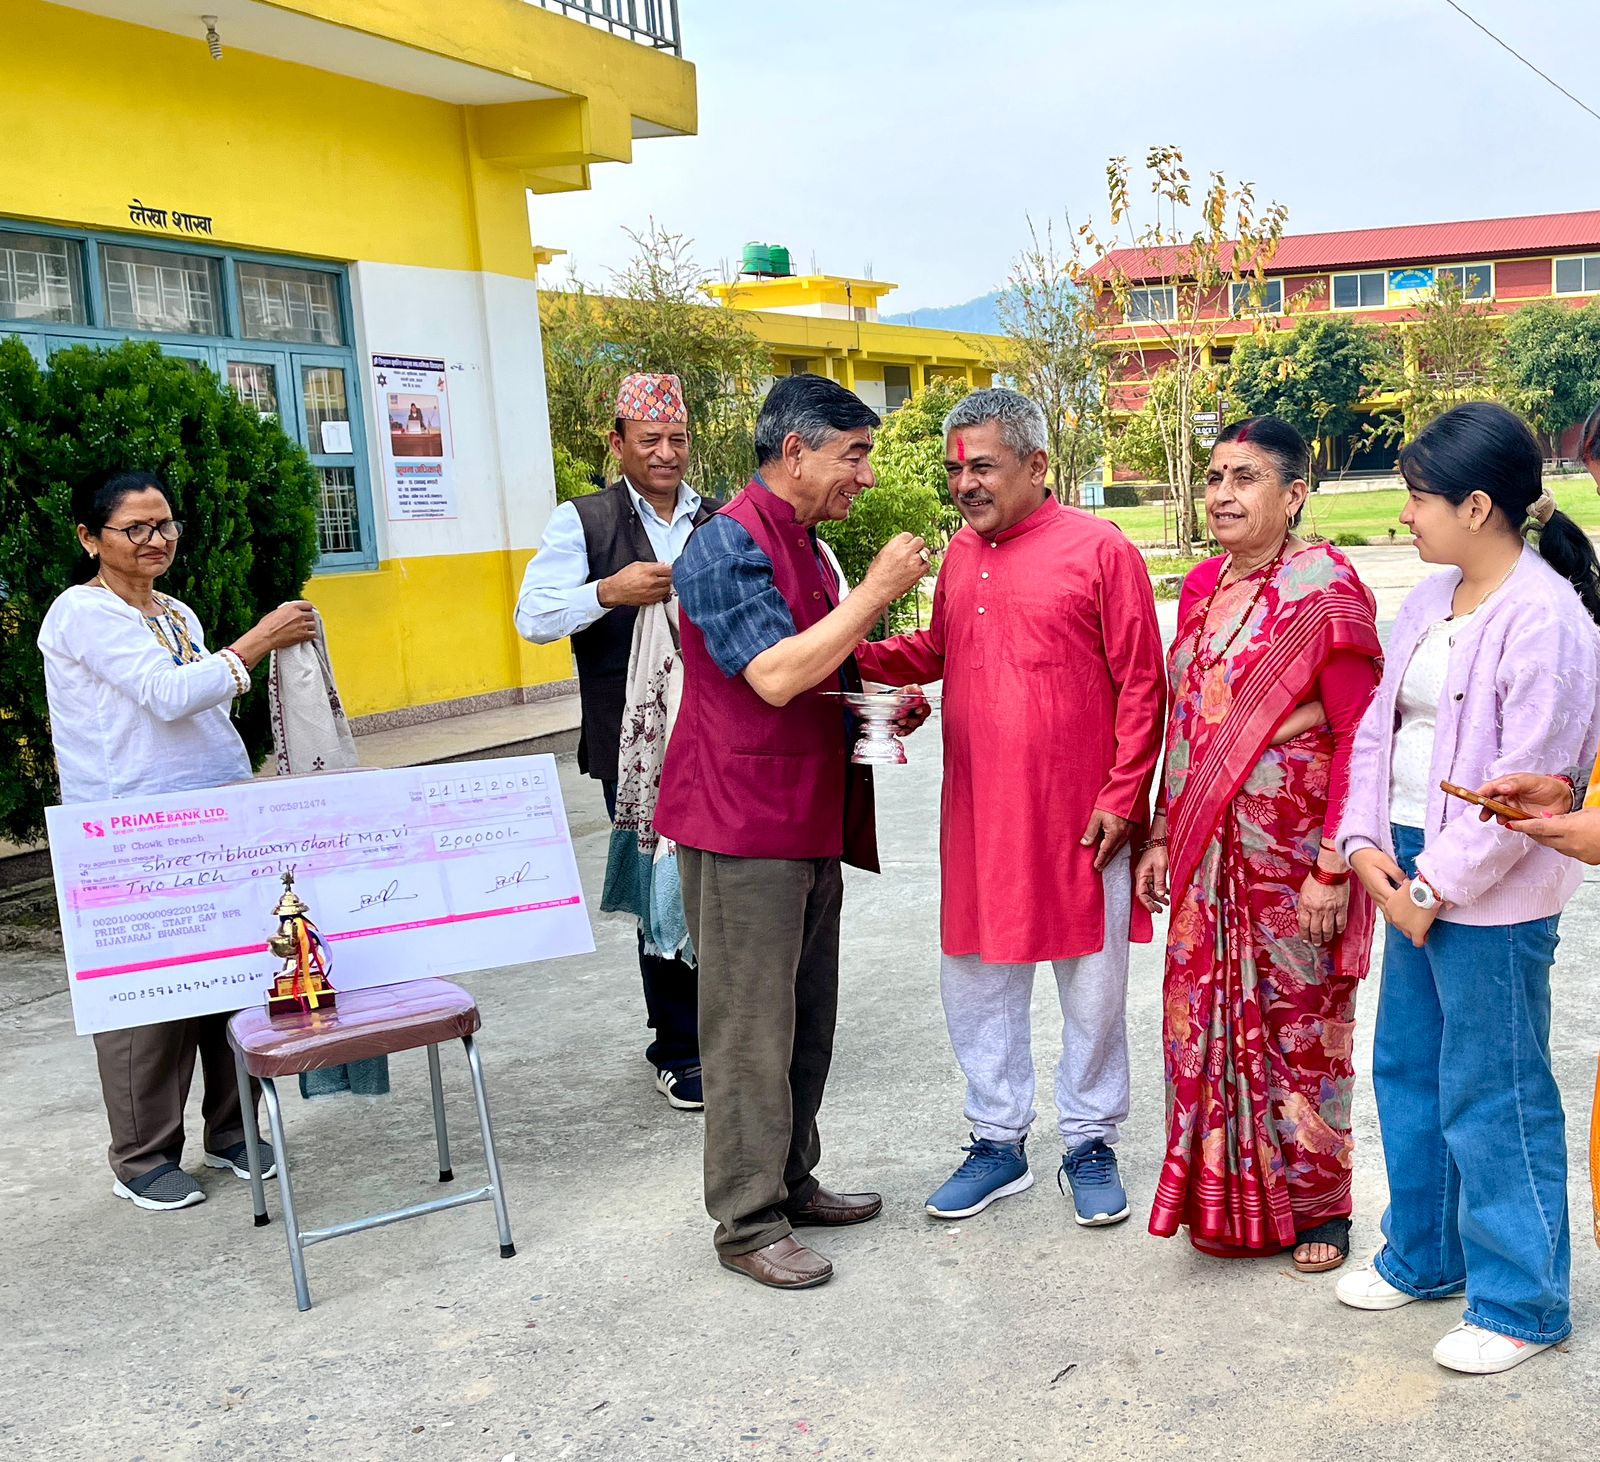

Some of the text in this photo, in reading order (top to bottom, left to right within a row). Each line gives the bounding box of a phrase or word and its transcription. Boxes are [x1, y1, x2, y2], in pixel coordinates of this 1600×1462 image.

[128, 198, 212, 235] लेखा शाखा
[167, 811, 201, 823] BANK
[113, 834, 205, 853] BP Chowk Branch
[95, 926, 126, 938] PRIME
[162, 917, 193, 928] STAFF
[199, 912, 217, 922] SAV
[222, 909, 241, 920] NPR
[96, 924, 207, 948] BIJAYARAJ BHANDARI
